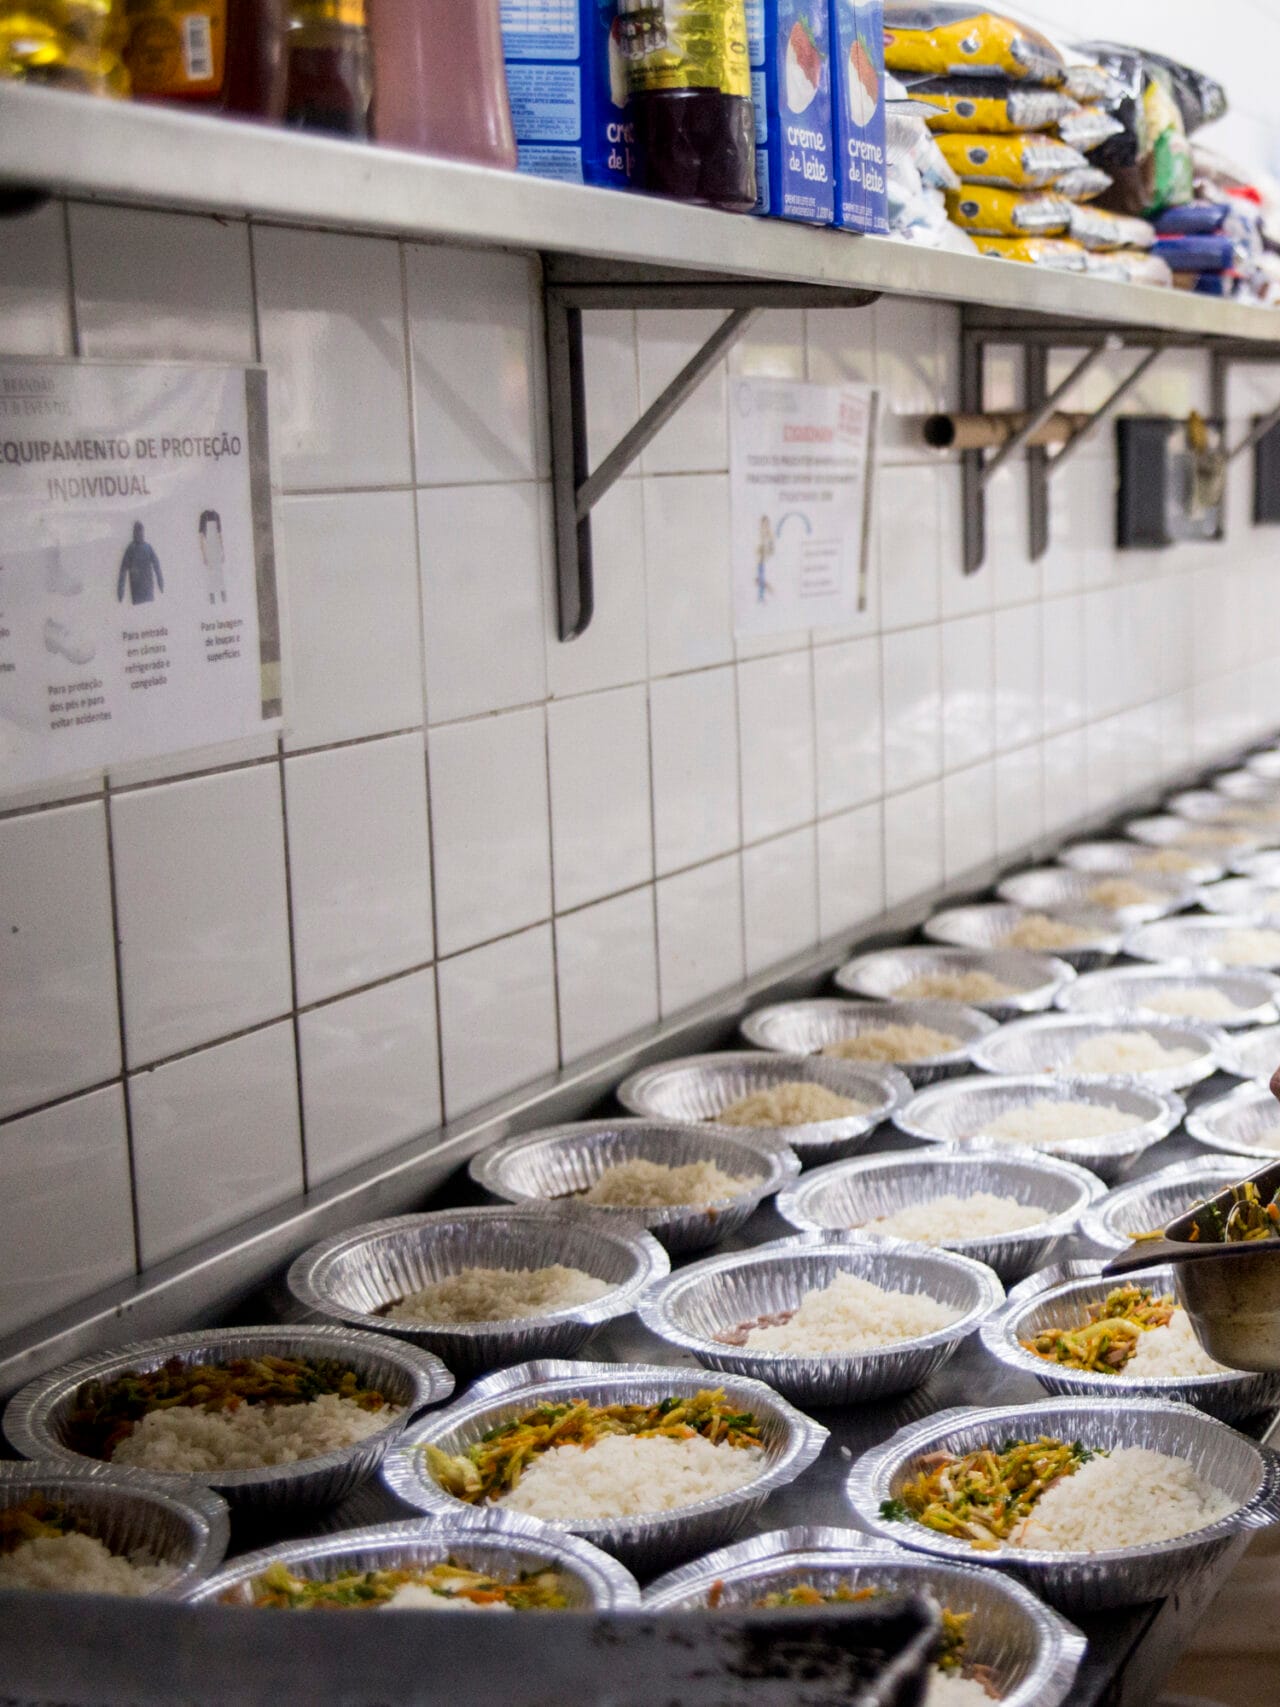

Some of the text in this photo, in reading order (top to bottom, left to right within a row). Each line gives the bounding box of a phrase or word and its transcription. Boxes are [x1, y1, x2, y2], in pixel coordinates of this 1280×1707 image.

[788, 126, 826, 152] creme
[848, 138, 883, 165] creme
[608, 148, 624, 170] de
[789, 151, 828, 182] de leite
[849, 160, 885, 194] de leite
[136, 438, 157, 459] DE
[162, 432, 241, 461] PROTEÇÃO
[48, 475, 151, 501] INDIVIDUAL
[122, 631, 139, 640] Para
[48, 685, 66, 696] Para
